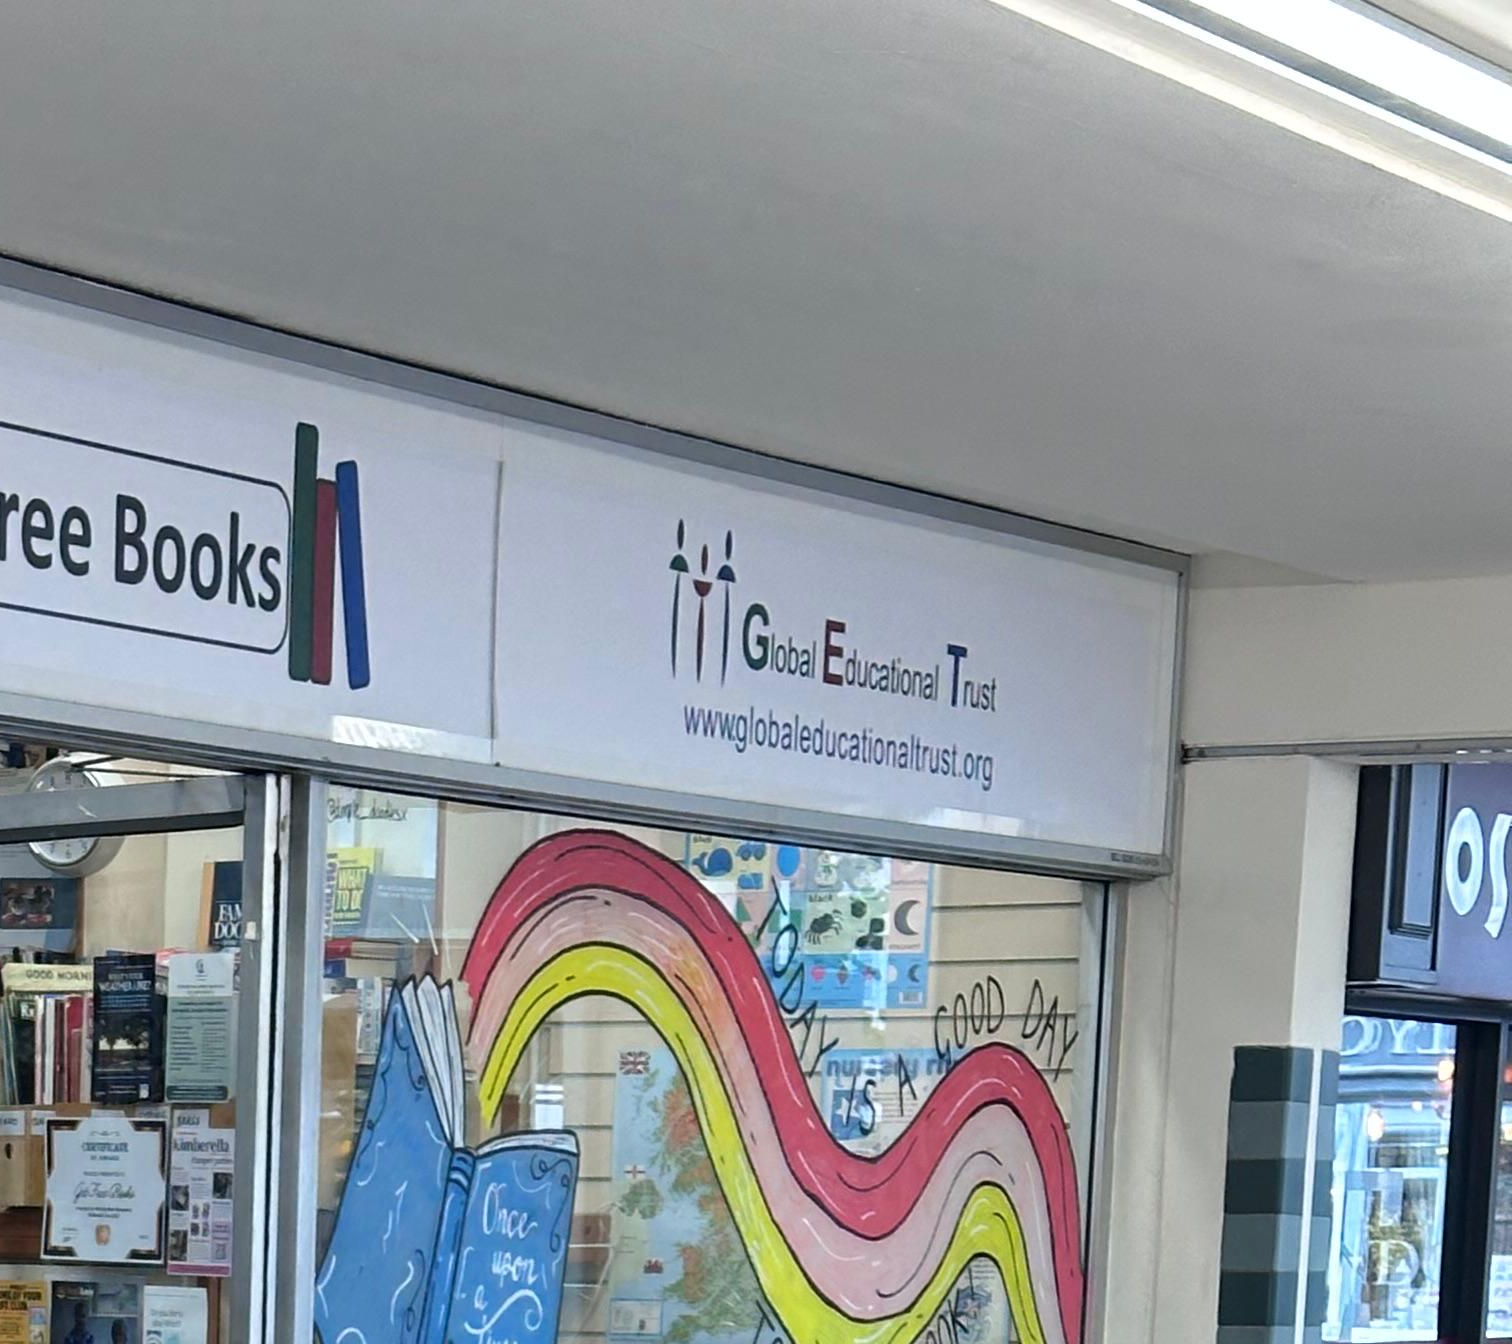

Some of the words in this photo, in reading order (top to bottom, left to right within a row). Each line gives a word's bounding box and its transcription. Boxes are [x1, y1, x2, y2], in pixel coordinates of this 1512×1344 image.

[115, 493, 282, 613] Books
[742, 603, 816, 679] Global
[823, 618, 939, 702] Educational
[946, 643, 997, 713] Trust
[684, 703, 994, 791] www.globaleducationaltrust.org
[756, 876, 839, 1078] TODAY
[844, 1074, 876, 1136] IS
[897, 1054, 917, 1117] A
[934, 975, 1004, 1070] GOOD
[1022, 979, 1078, 1083] DAY
[481, 1182, 538, 1240] Once
[474, 1284, 488, 1311] a
[491, 1250, 539, 1288] upon
